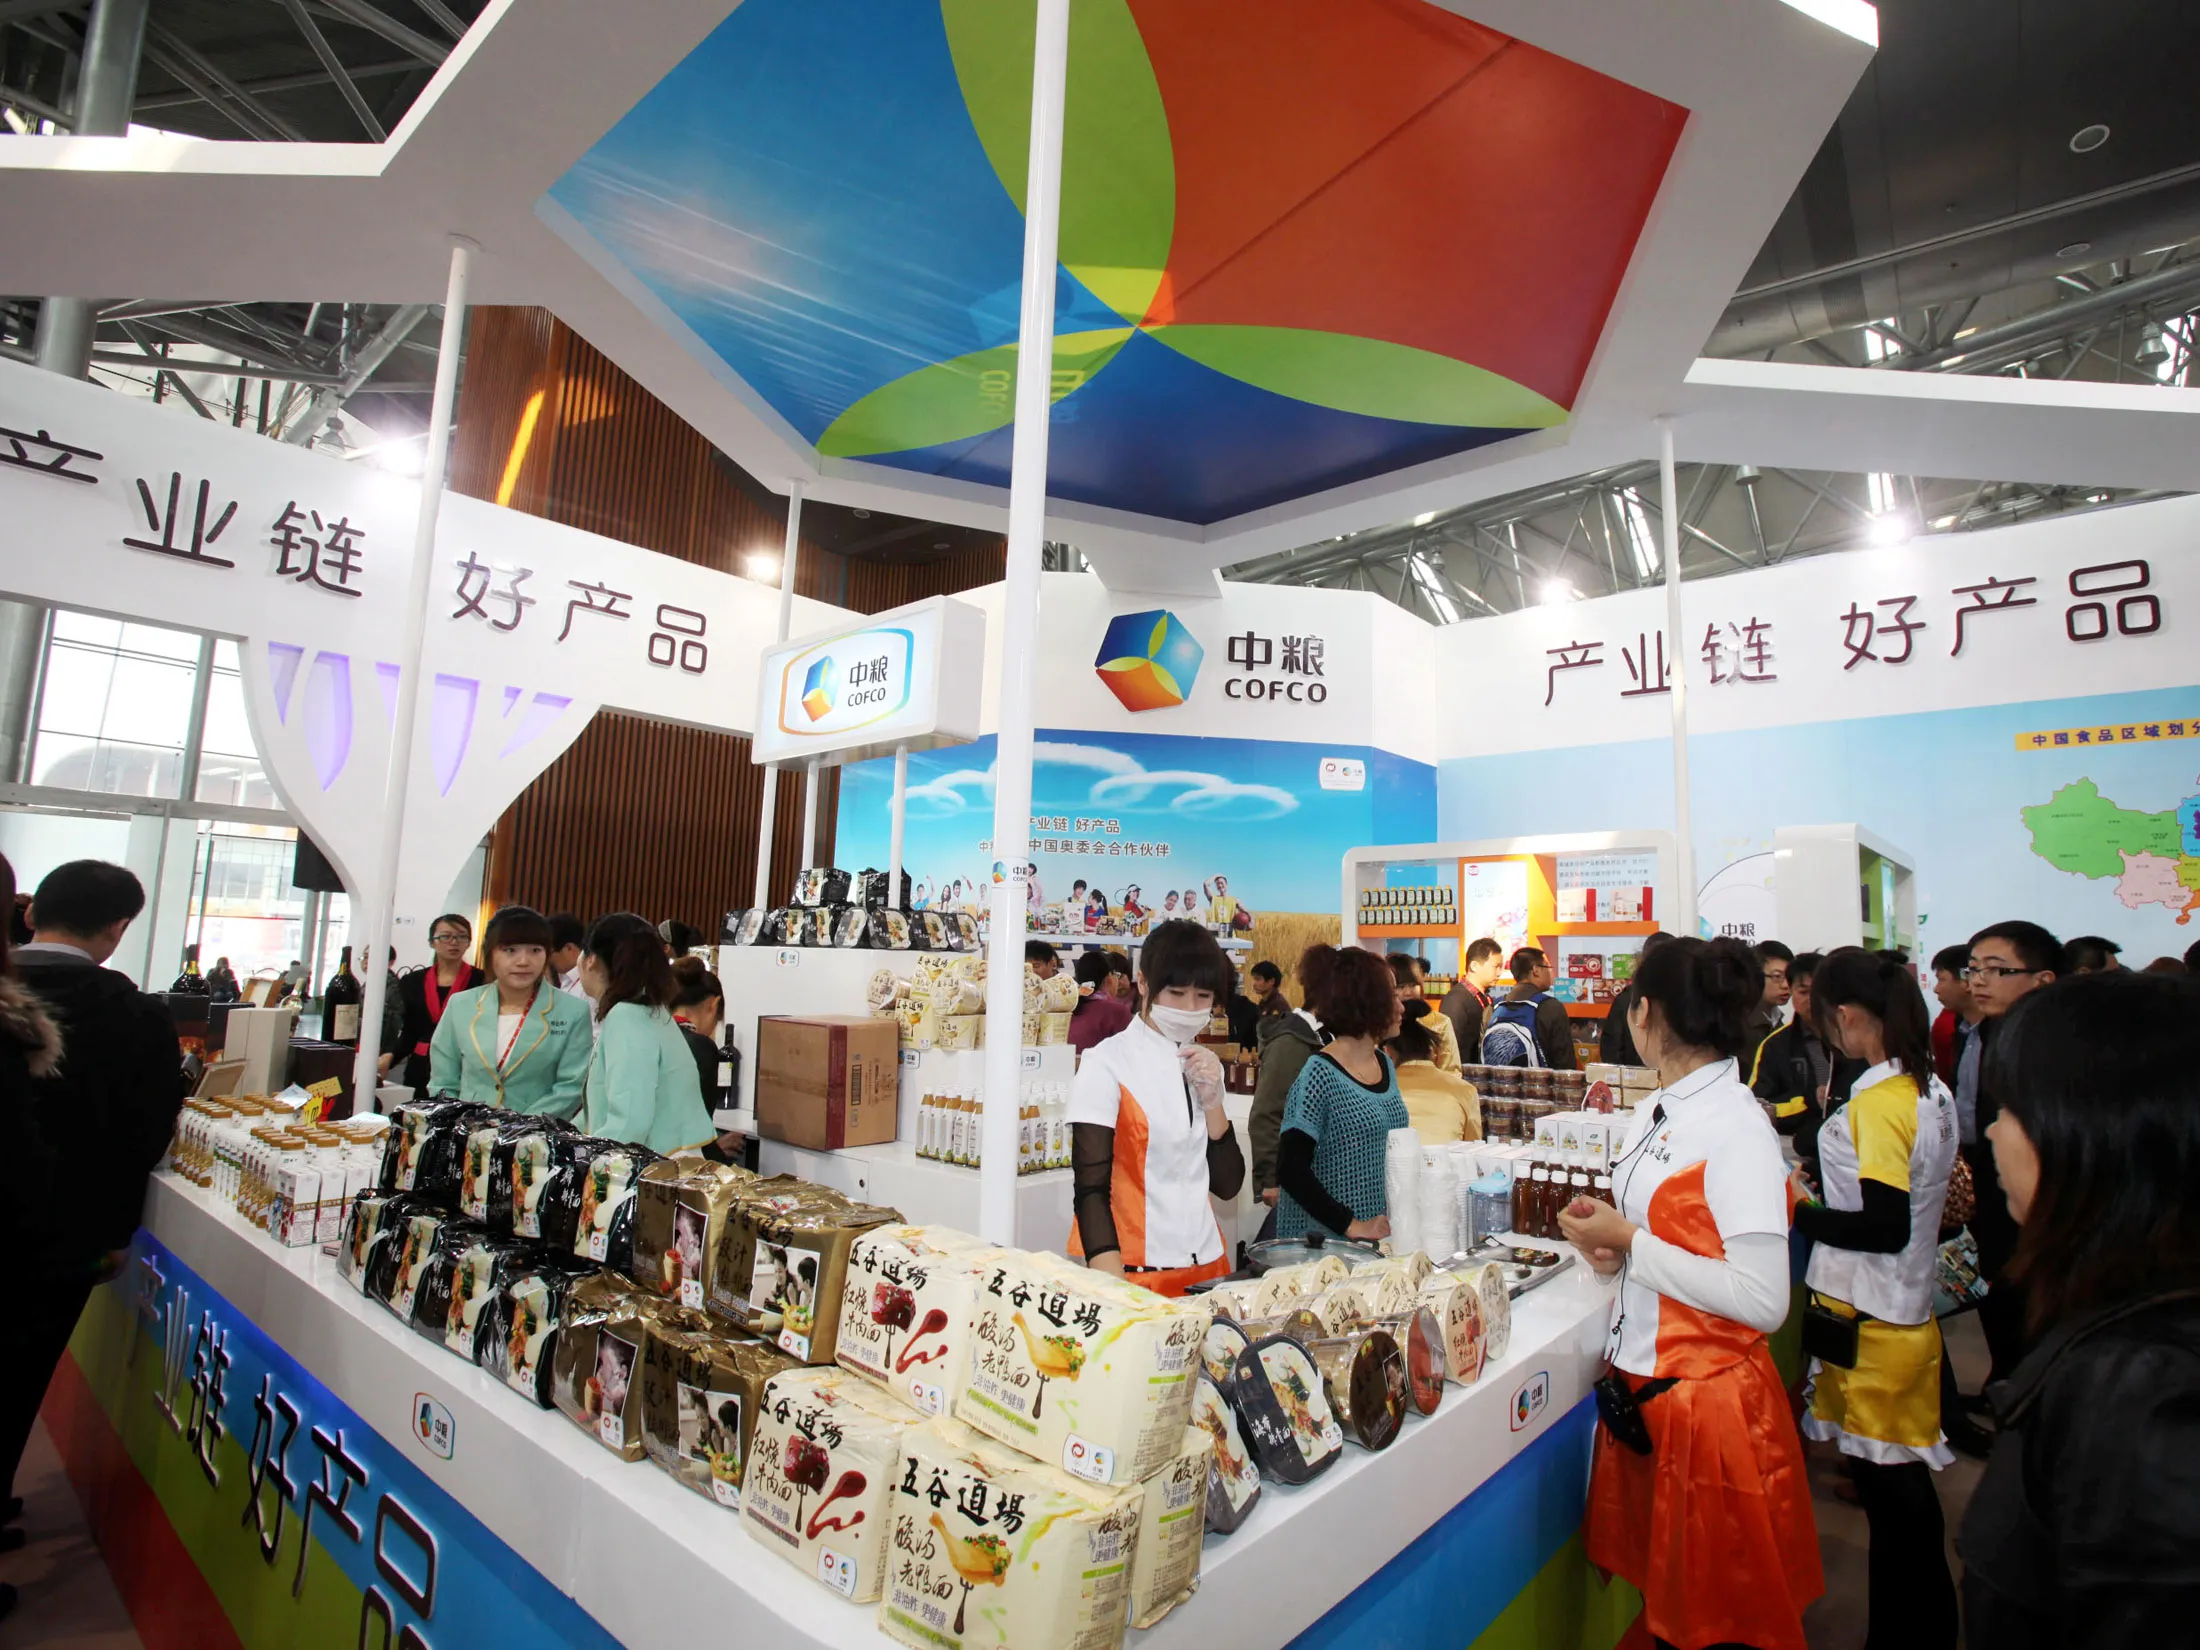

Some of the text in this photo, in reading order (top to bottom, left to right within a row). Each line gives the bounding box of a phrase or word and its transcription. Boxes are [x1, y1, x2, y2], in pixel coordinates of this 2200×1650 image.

[0, 429, 709, 674] 产业链 好产品
[1228, 631, 1324, 676] 中粮
[1545, 558, 2162, 708] 产业链 好产品
[849, 655, 888, 687] 中粮
[1225, 678, 1327, 703] COFCO
[847, 687, 886, 707] COFCO
[1075, 817, 1120, 834] 好产品
[1028, 838, 1170, 858] 中国奥委会合作伙伴
[1721, 922, 1755, 937] 中粮
[848, 1240, 928, 1291] 五谷道場
[987, 1268, 1103, 1338] 五谷道場
[981, 1351, 1031, 1389] 老鸭面
[760, 1382, 844, 1450] 五谷道場
[754, 1463, 792, 1502] 牛肉面
[900, 1457, 1025, 1535] 五谷道場
[894, 1513, 936, 1560] 酸汤
[899, 1559, 954, 1600] 老鸭面
